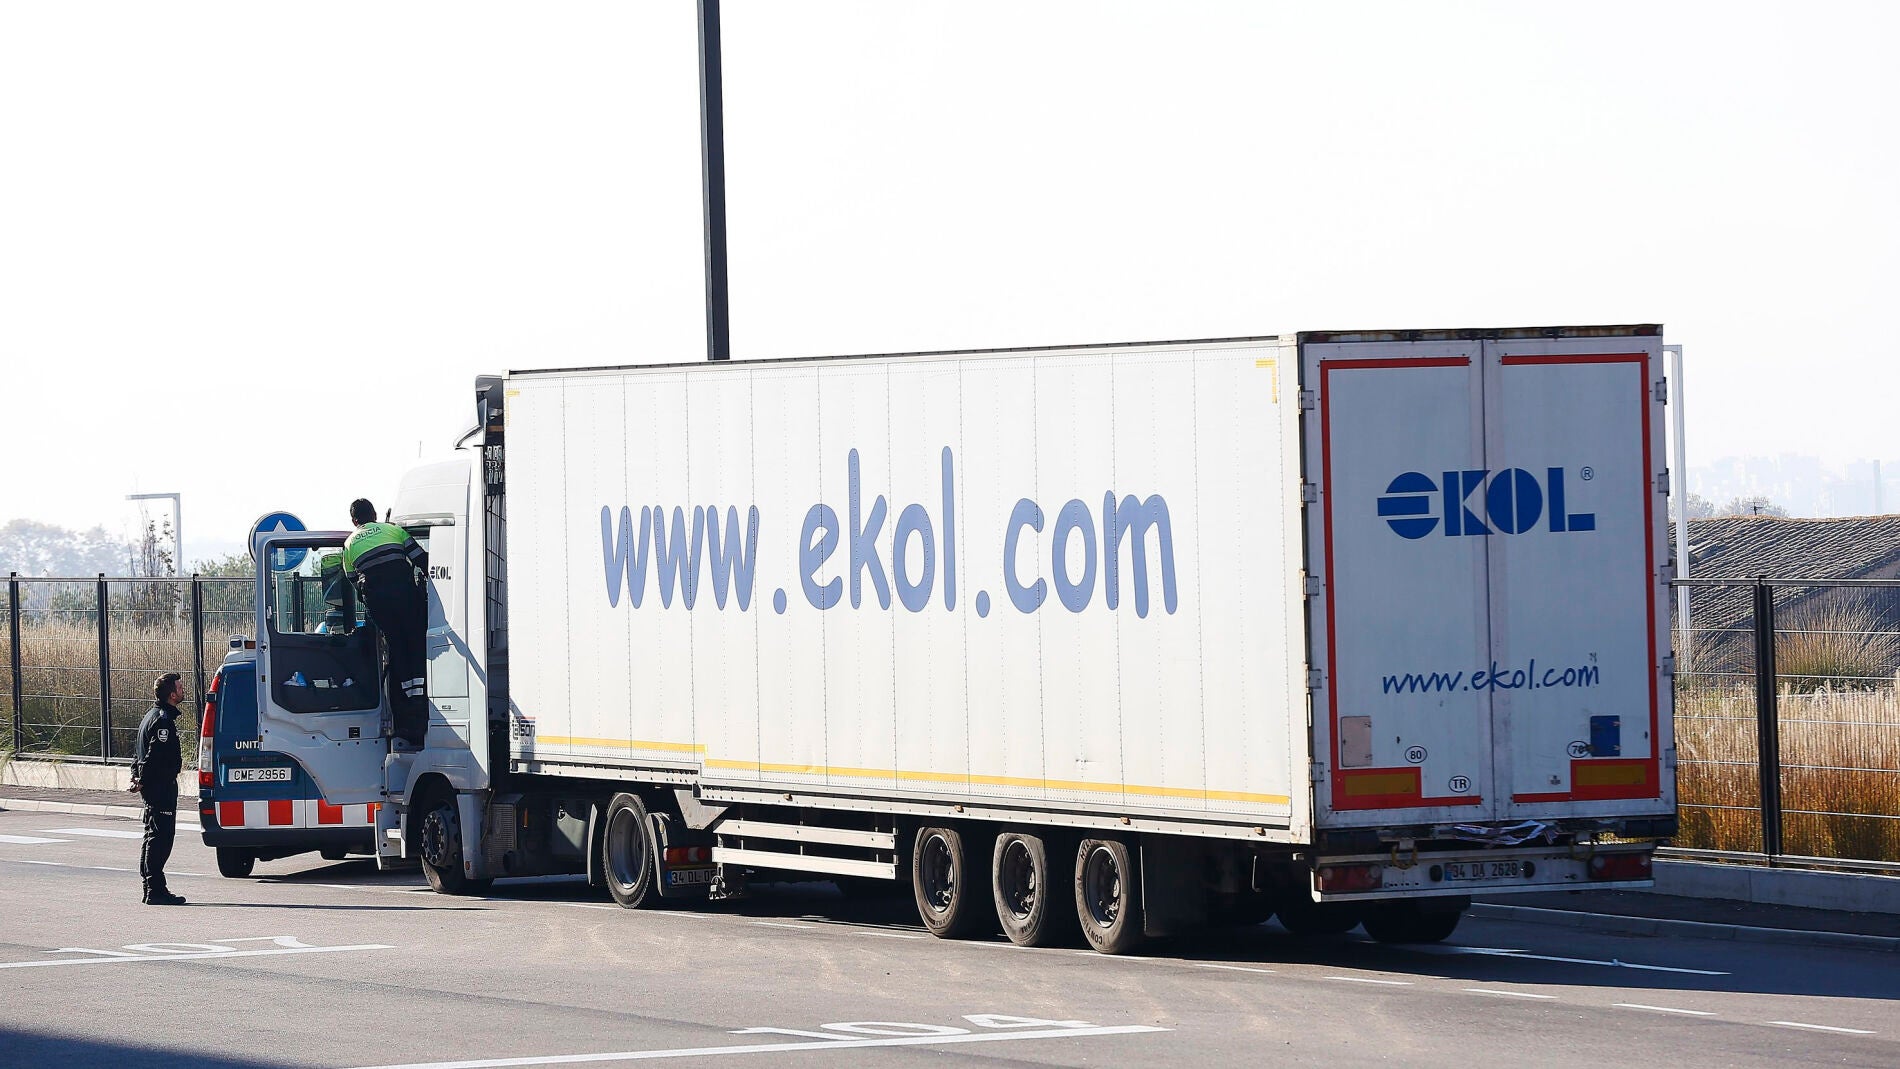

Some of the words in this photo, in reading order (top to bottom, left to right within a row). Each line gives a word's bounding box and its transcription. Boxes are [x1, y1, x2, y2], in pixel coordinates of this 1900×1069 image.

[1377, 467, 1596, 540] EKOL
[601, 446, 1178, 620] www.ekol.com
[1383, 658, 1600, 695] www.ekol.com
[1410, 750, 1422, 760] 80
[234, 769, 255, 780] CME
[258, 769, 286, 780] 2956
[1453, 779, 1467, 789] TR
[672, 870, 685, 884] 34
[1452, 864, 1465, 878] 34
